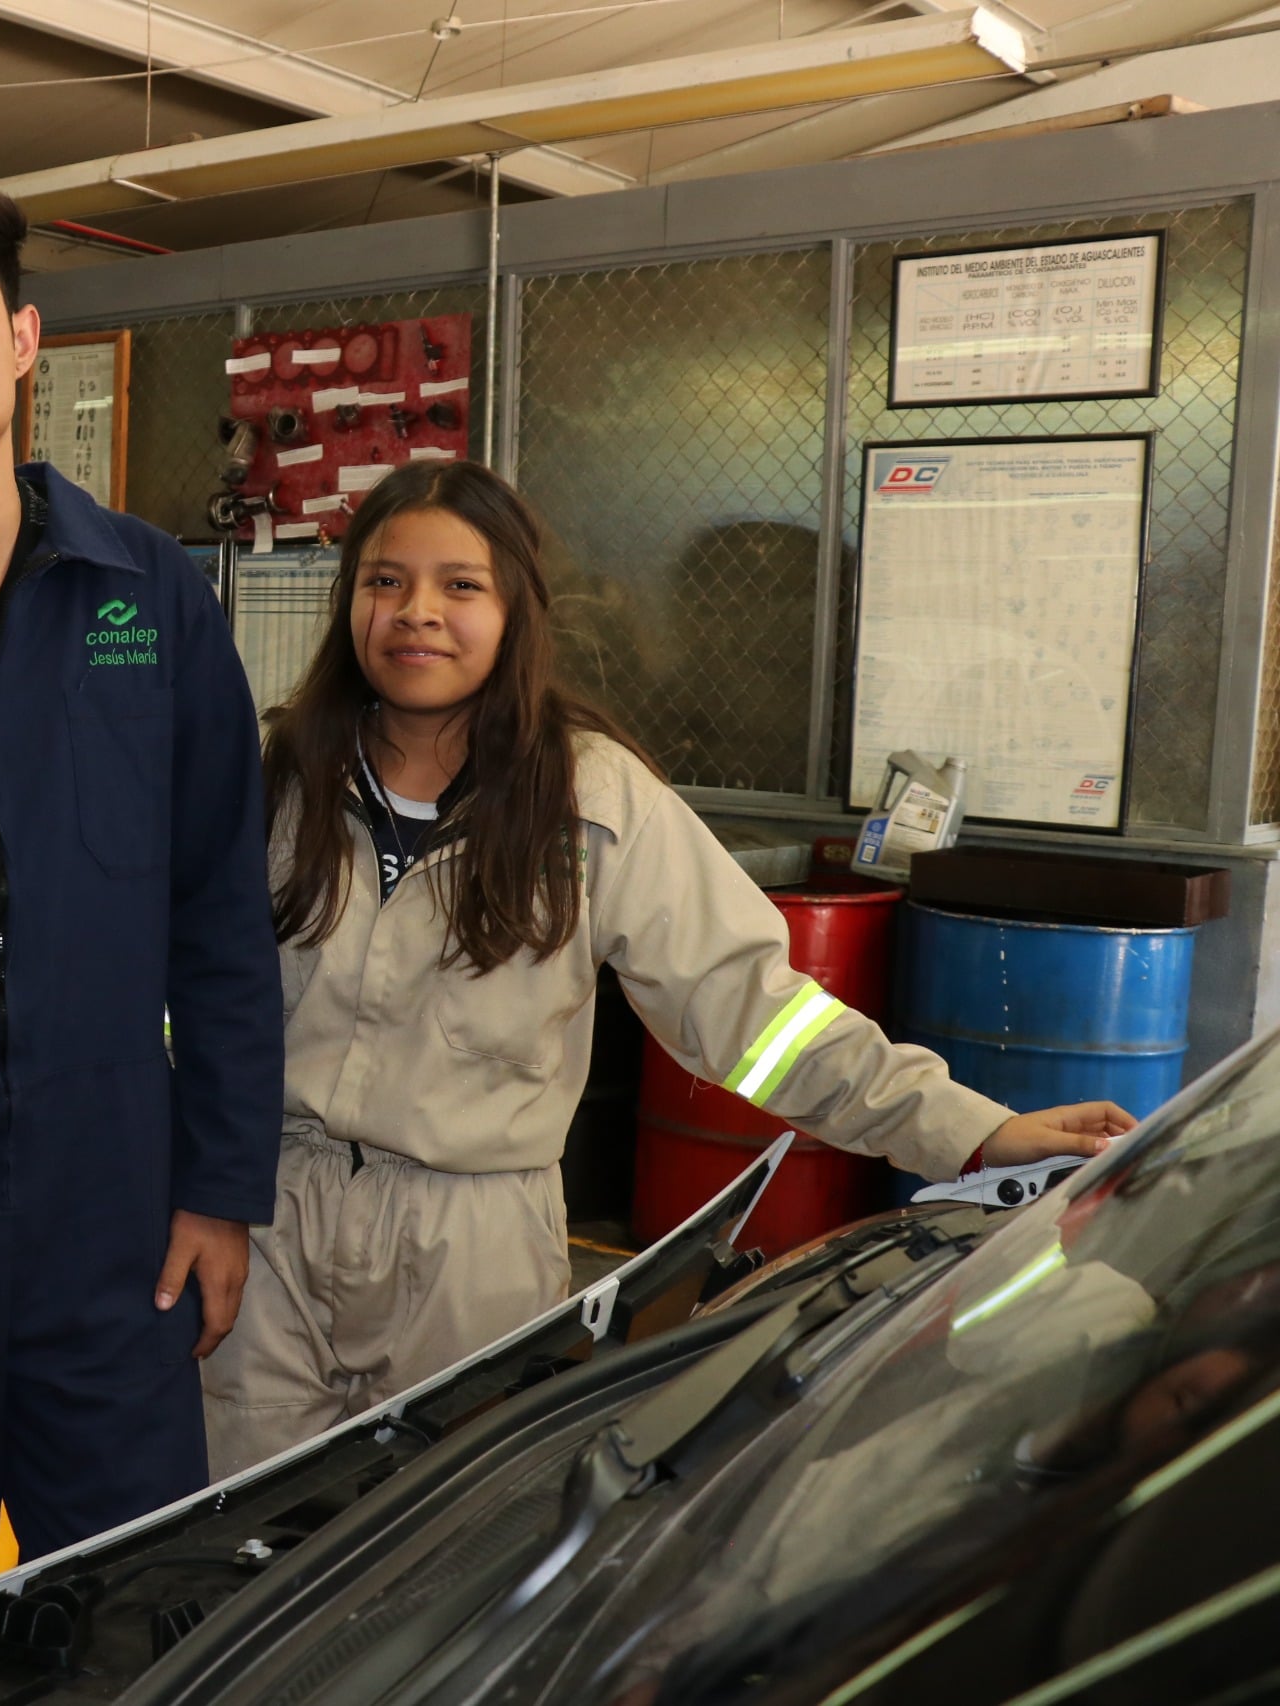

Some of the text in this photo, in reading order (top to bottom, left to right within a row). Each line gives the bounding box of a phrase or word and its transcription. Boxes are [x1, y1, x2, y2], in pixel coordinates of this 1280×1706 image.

[916, 246, 1145, 277] INSTITUTO DEL MEDIO AMBIENTE DEL ESTADO DE AGUASCALIENTES
[968, 269, 1012, 279] PARAMETROS
[1026, 263, 1087, 274] CONTAMINANTES
[966, 311, 995, 322] (HC)
[1008, 308, 1040, 320] (CO)
[888, 466, 940, 483] DC
[86, 626, 158, 646] conalep
[89, 647, 157, 666] Jesús María
[1079, 779, 1109, 789] DC
